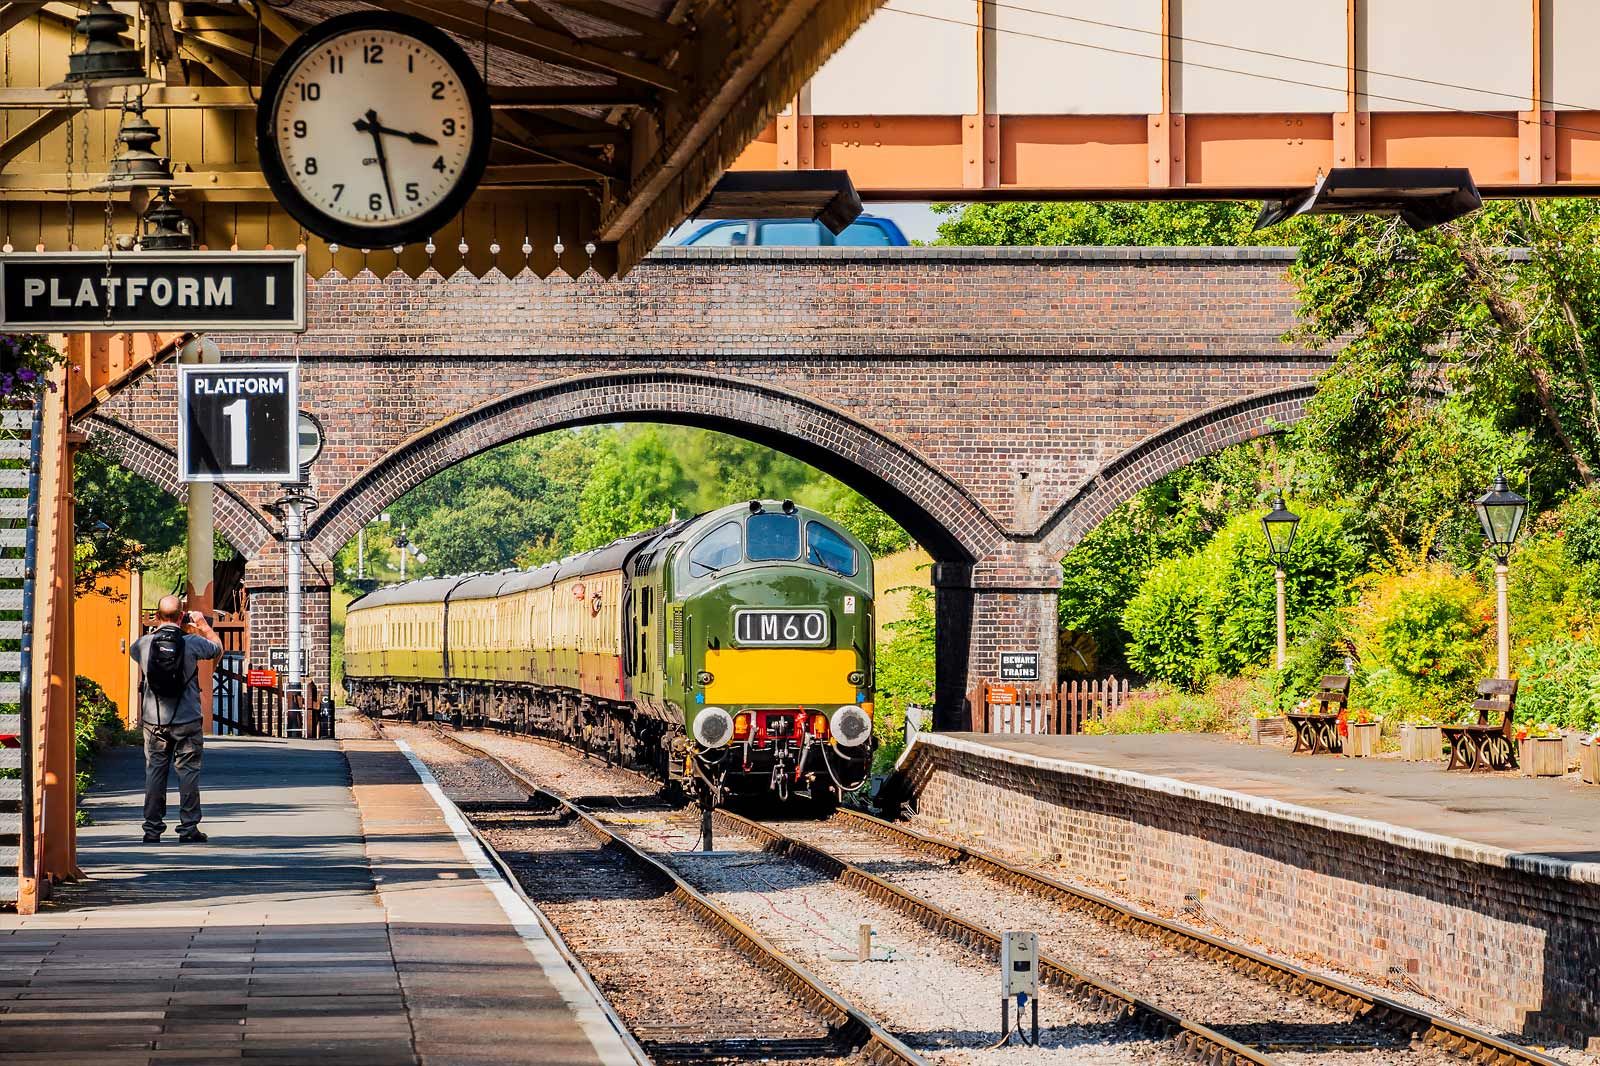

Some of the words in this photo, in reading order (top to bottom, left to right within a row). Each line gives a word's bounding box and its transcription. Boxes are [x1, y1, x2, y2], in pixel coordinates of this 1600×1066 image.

[364, 45, 384, 64] 12
[408, 54, 414, 73] 1
[330, 55, 344, 74] 11
[301, 82, 321, 101] 10
[431, 81, 445, 100] 2
[294, 120, 307, 138] 9
[442, 119, 456, 137] 3
[305, 157, 318, 175] 8
[432, 155, 447, 173] 4
[332, 183, 345, 201] 7
[406, 182, 420, 201] 5
[369, 193, 382, 211] 6
[24, 276, 233, 307] PLATFORM
[194, 377, 283, 394] PLATFORM
[223, 398, 248, 465] 1
[1481, 735, 1510, 766] GWR
